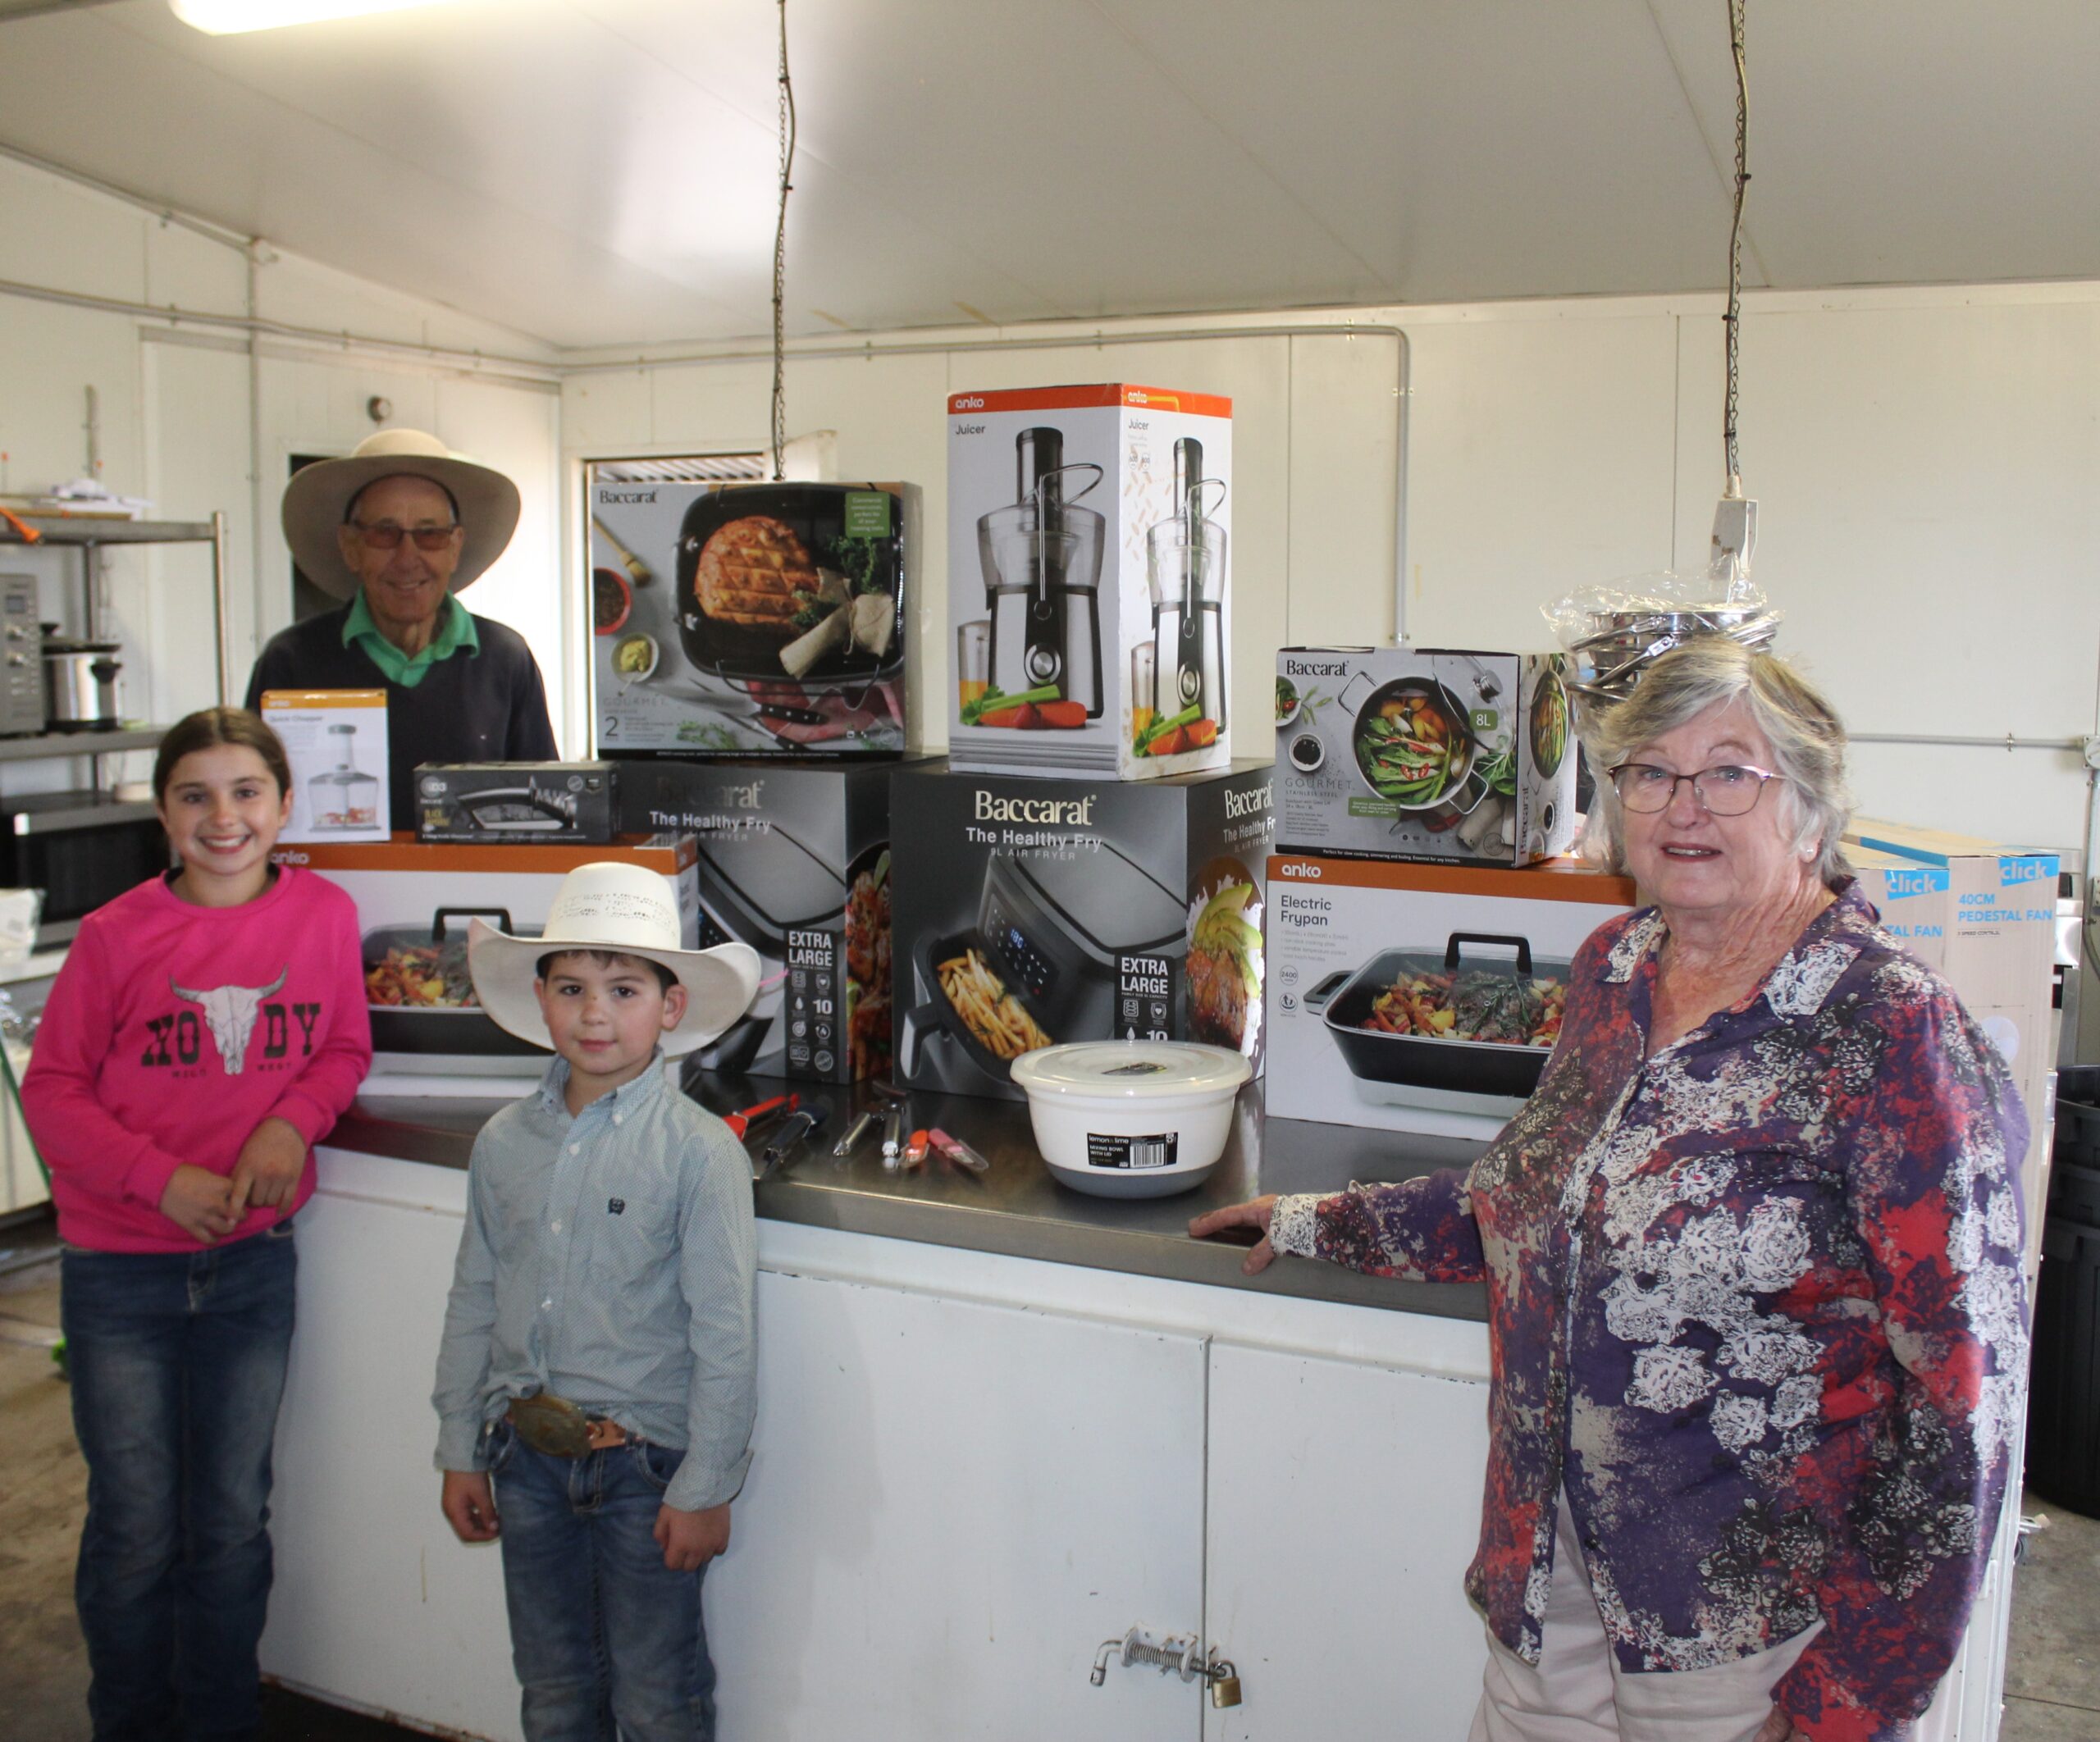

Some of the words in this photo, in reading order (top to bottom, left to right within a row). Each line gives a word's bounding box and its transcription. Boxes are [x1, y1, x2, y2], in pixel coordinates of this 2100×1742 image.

[956, 396, 984, 408] anko
[1127, 390, 1148, 404] anko
[956, 424, 985, 435] Juicer
[1129, 419, 1148, 430] Juicer
[600, 490, 657, 504] Baccarat
[1287, 659, 1347, 677] Baccarat
[605, 716, 618, 736] 2
[1477, 714, 1491, 727] 8L
[1285, 778, 1352, 789] GOURMET
[1224, 780, 1274, 819] Baccarat
[975, 790, 1093, 826] Baccarat
[649, 811, 678, 826] The
[682, 812, 740, 833] Healthy
[746, 817, 771, 835] Fry
[1223, 828, 1238, 844] The
[1239, 820, 1266, 839] Healthy
[1267, 816, 1276, 830] Fr
[711, 832, 748, 841] FRYER
[966, 827, 997, 843] The
[1002, 829, 1066, 850] Healthy
[1074, 833, 1102, 853] Fry
[1253, 835, 1269, 846] FRYER
[271, 850, 310, 864] anko
[990, 847, 1002, 856] 9L
[1008, 849, 1028, 858] AIR
[1034, 850, 1075, 860] FRYER
[1281, 862, 1322, 878] anko
[2000, 860, 2048, 880] click
[1888, 873, 1937, 892] click
[1281, 895, 1331, 910] Electric
[1958, 893, 1996, 905] 40CM
[1281, 910, 1328, 927] Frypan
[1957, 910, 2022, 922] PEDESTAL
[2026, 910, 2052, 921] FAN
[1915, 924, 1943, 937] FAN
[788, 931, 832, 949] EXTRA
[789, 948, 833, 967] LARGE
[1121, 956, 1168, 976] EXTRA
[1121, 975, 1168, 995] LARGE
[813, 999, 833, 1015] 10
[1089, 1135, 1109, 1143] lemon
